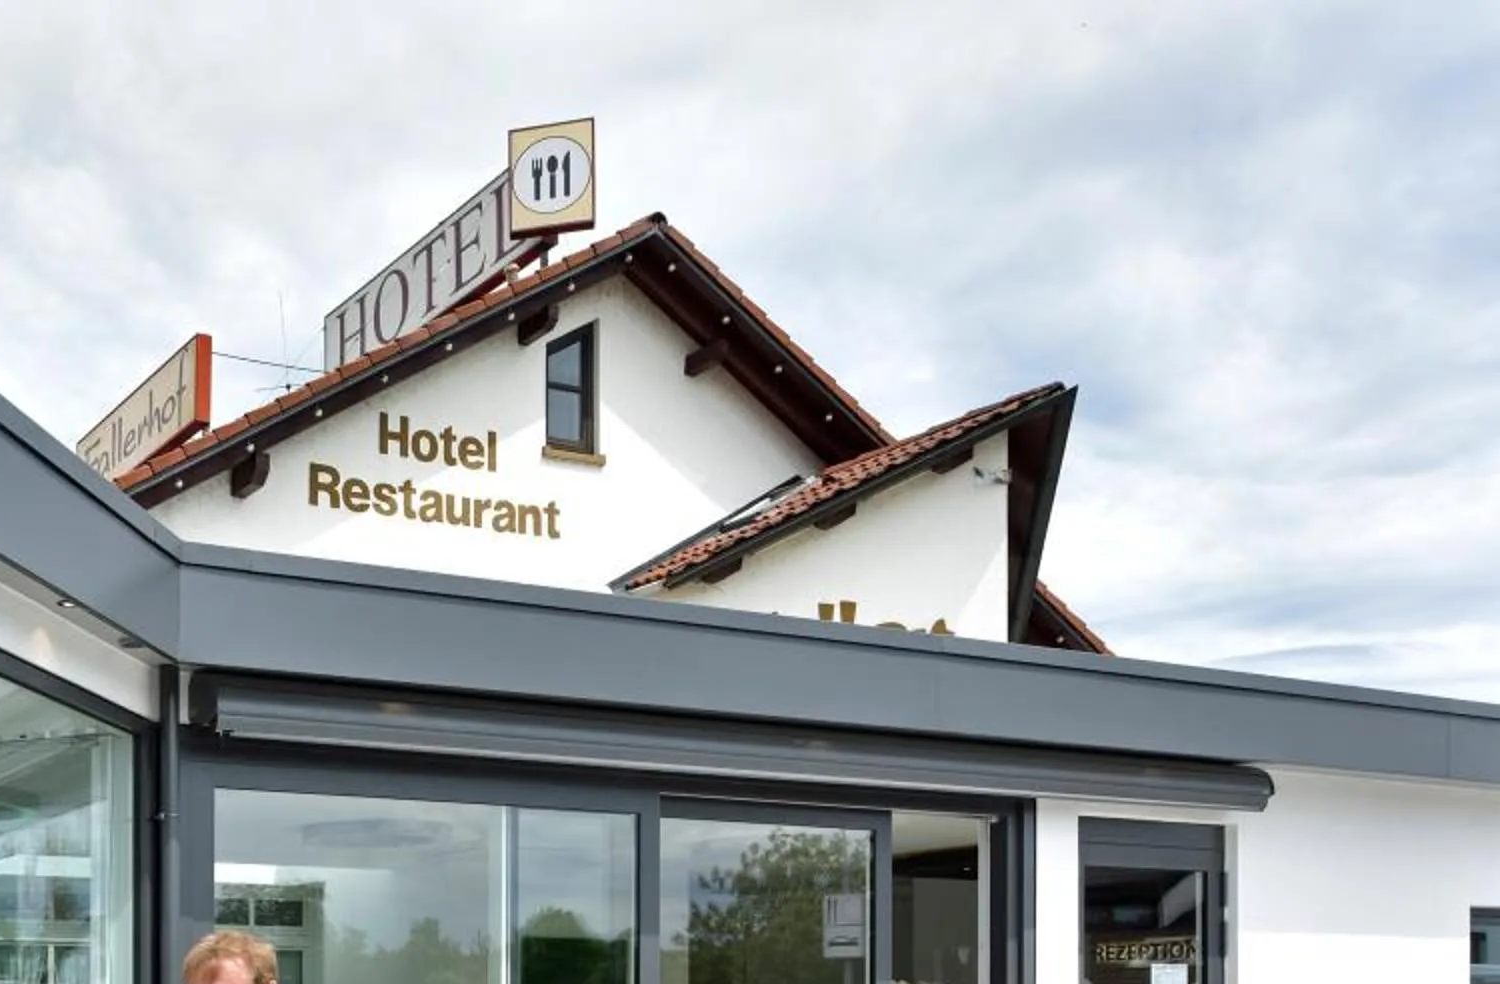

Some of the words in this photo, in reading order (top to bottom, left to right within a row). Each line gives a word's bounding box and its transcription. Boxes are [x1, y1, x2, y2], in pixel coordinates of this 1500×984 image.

[335, 177, 530, 366] HOTEL
[378, 411, 497, 473] Hotel
[308, 462, 561, 539] Restaurant
